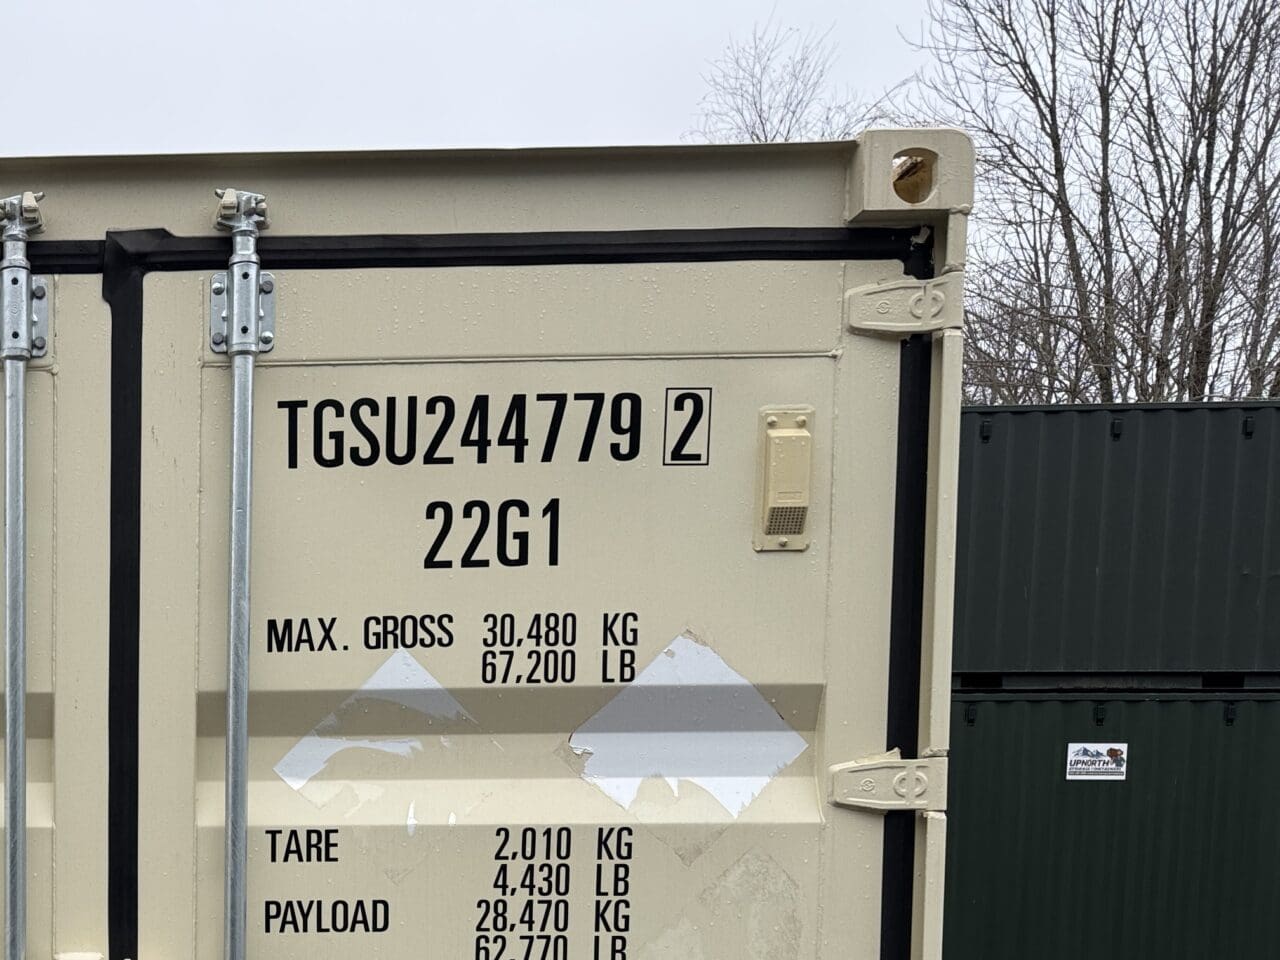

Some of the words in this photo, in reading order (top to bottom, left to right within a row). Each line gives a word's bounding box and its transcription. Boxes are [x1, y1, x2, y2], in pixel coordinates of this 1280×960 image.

[276, 392, 642, 469] TGSU244779
[669, 392, 705, 462] 2
[423, 498, 561, 570] 22G1
[266, 617, 350, 653] MAX.
[363, 614, 455, 650] GROSS
[602, 612, 639, 647] KG
[601, 649, 637, 684] LB
[1069, 759, 1110, 767] UPNORTH
[264, 829, 339, 863] TARE
[595, 827, 633, 861] KG
[595, 863, 630, 897] LB
[264, 899, 390, 934] PAYLOAD
[594, 899, 631, 933] KG
